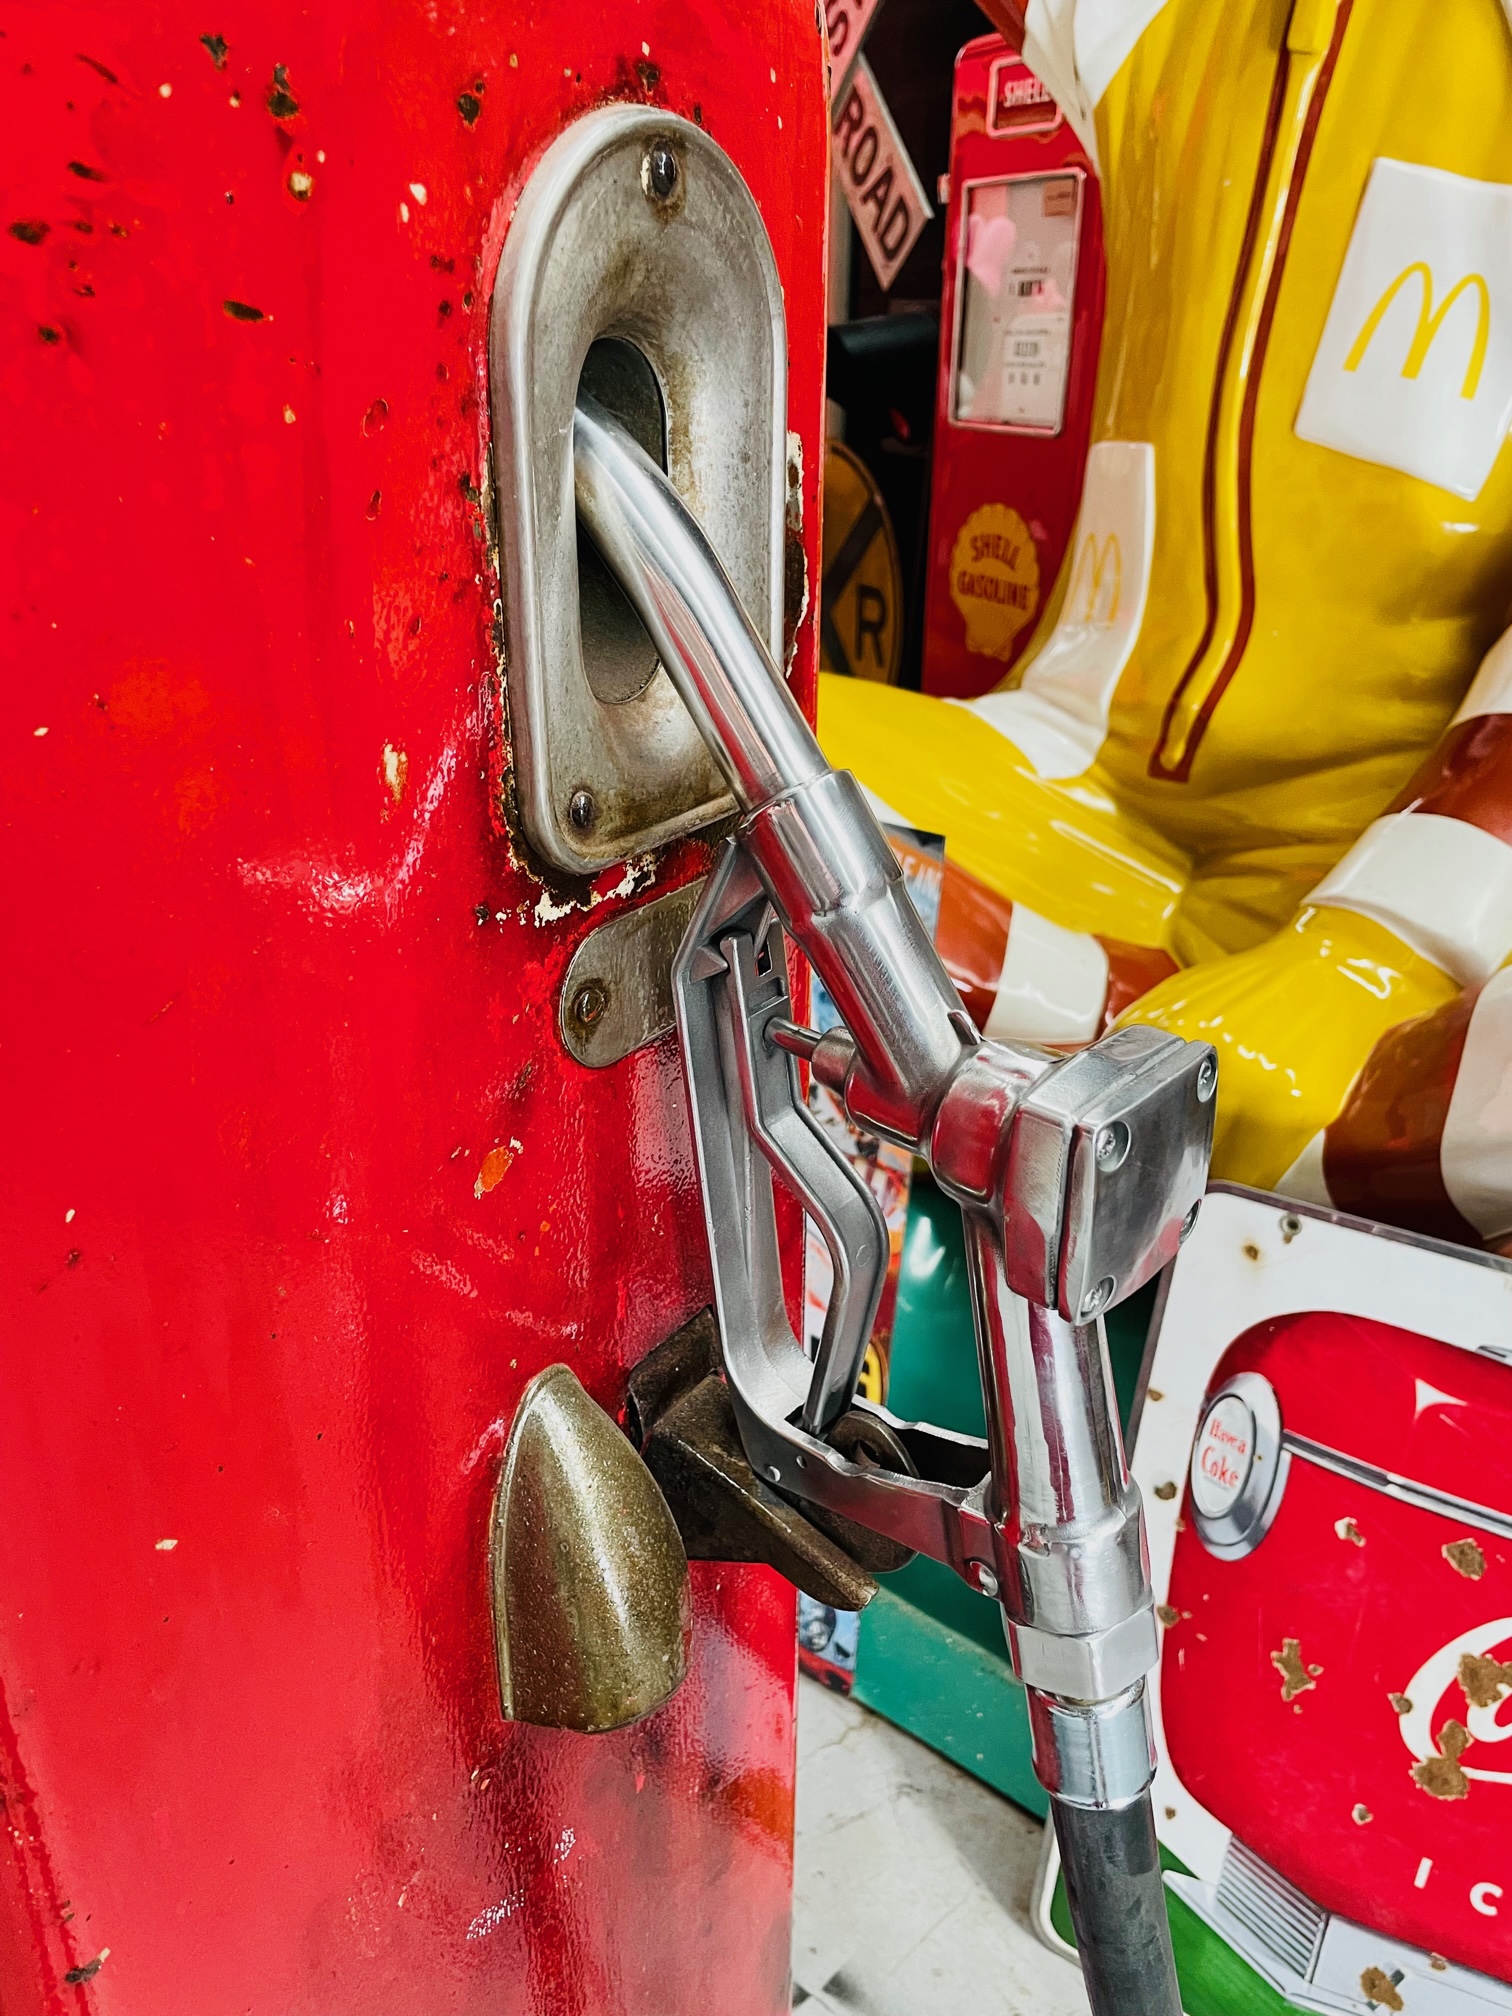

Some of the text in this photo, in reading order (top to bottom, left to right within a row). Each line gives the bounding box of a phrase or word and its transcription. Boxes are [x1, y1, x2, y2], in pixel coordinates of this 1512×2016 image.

[833, 84, 910, 260] ROAD
[969, 533, 1021, 571] SHELL
[957, 570, 1030, 612] GASOLINE
[856, 584, 886, 669] R
[1209, 1418, 1238, 1446] Have
[1201, 1445, 1239, 1489] Coke
